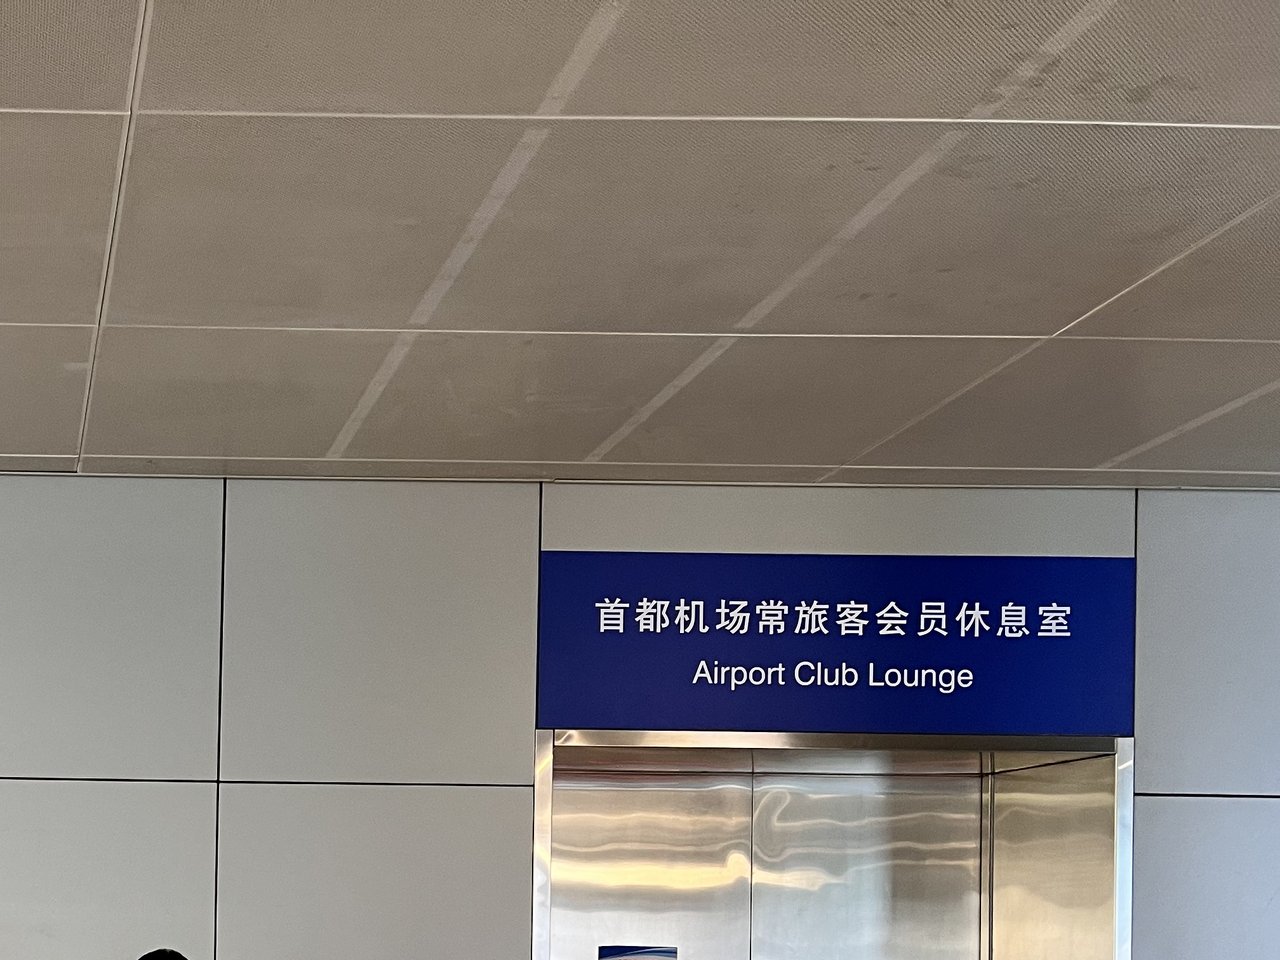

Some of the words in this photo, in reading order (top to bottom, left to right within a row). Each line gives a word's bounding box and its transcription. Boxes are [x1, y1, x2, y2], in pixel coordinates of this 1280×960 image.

[595, 596, 1072, 639] 首都机场常旅客会员休息室
[692, 660, 786, 691] Airport
[794, 660, 859, 687] Club
[868, 661, 974, 694] Lounge
